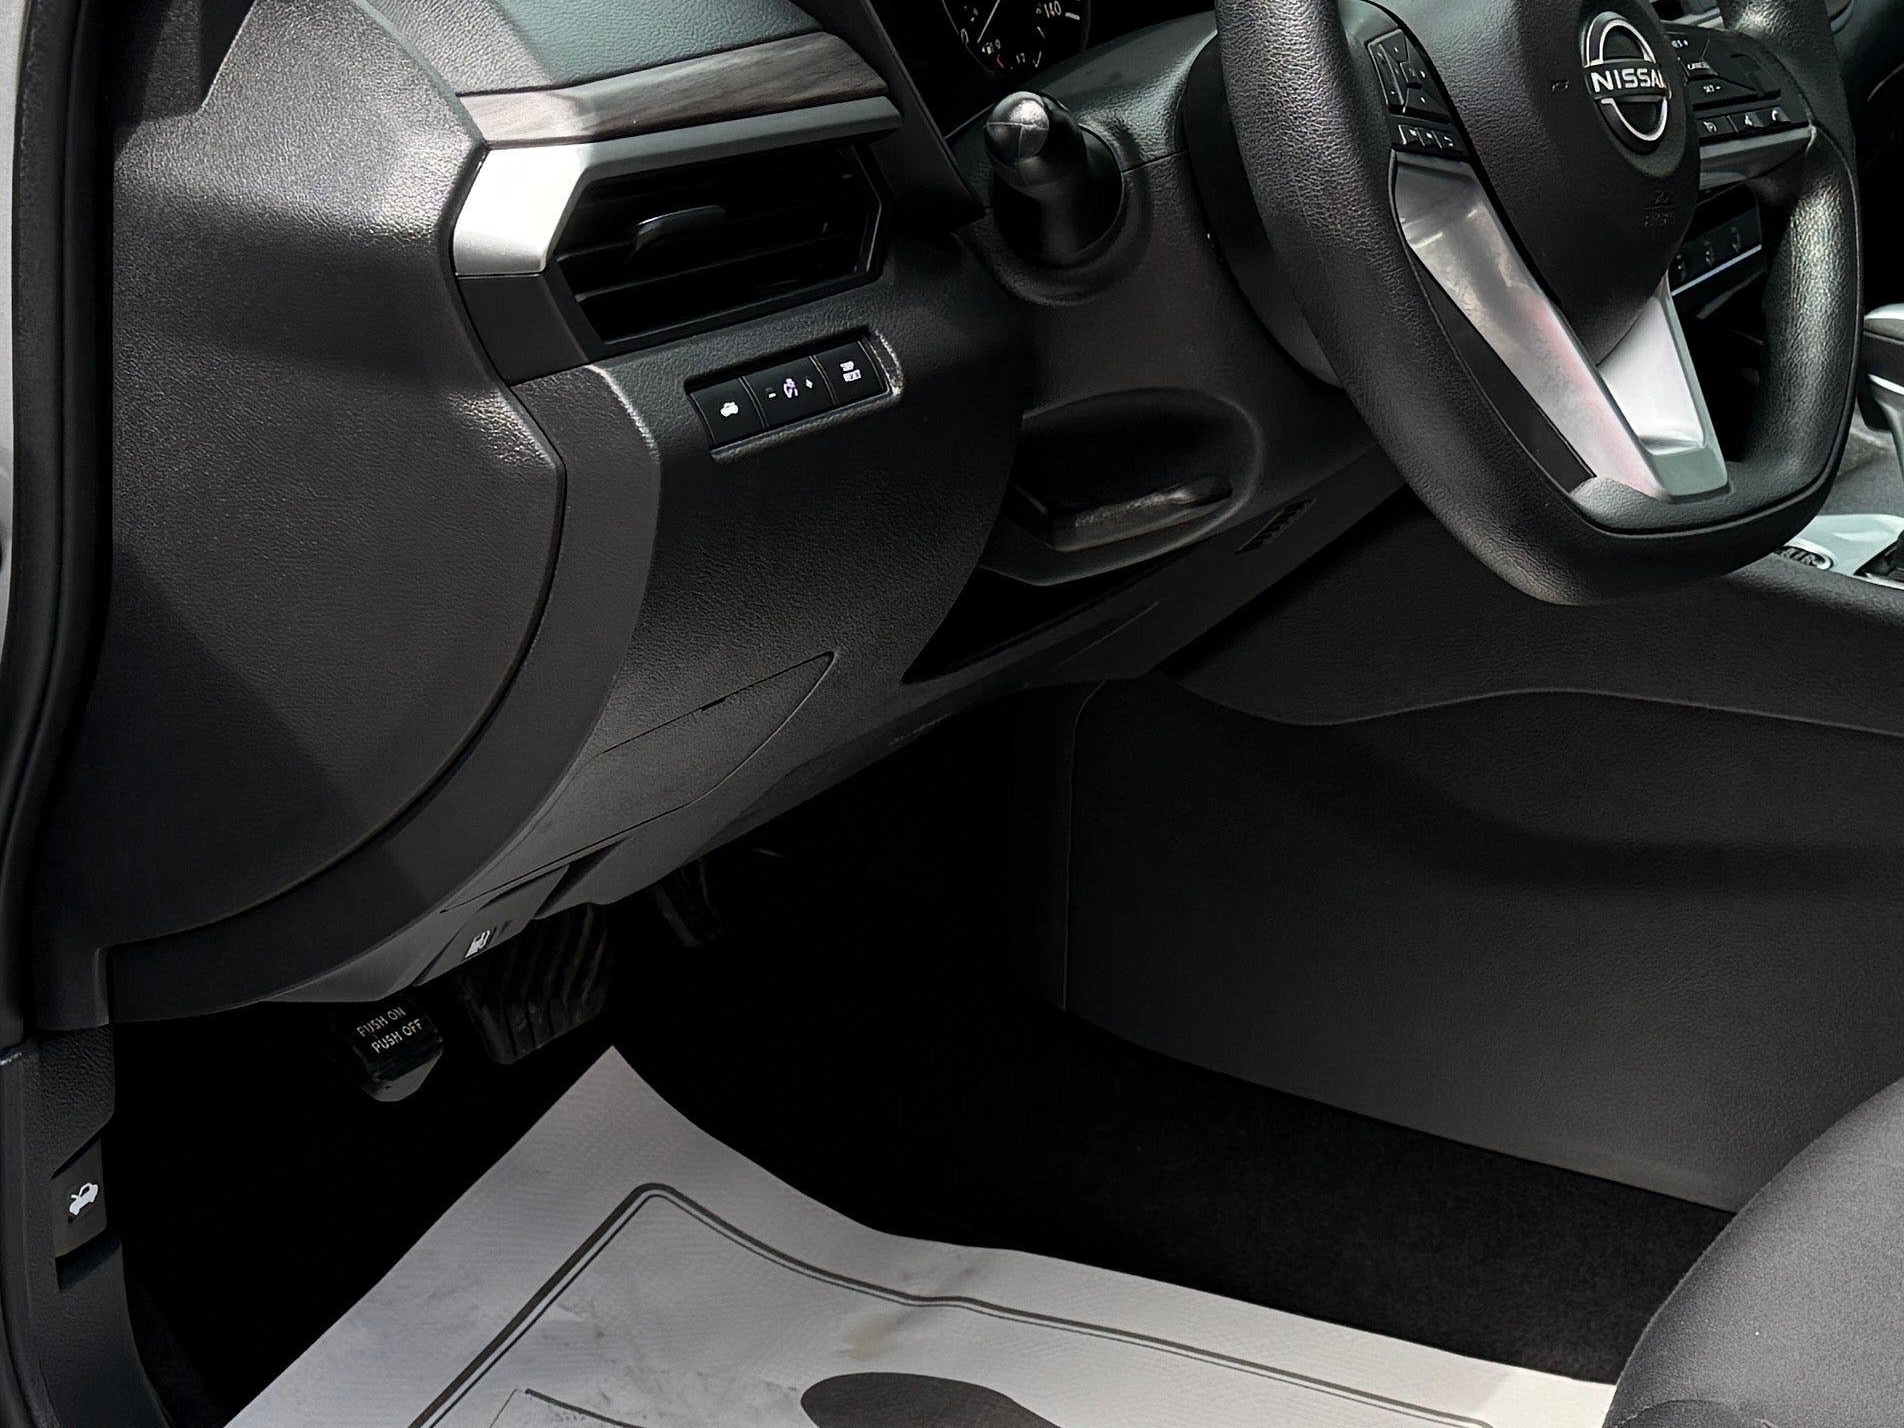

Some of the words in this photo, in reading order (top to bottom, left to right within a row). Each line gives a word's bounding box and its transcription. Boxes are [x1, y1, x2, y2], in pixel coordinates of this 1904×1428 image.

[1044, 0, 1062, 18] 140
[960, 28, 969, 44] 0
[356, 1014, 388, 1038] PUSH
[386, 1006, 407, 1023] ON
[370, 1030, 404, 1055] PUSH
[402, 1018, 425, 1037] OFF
